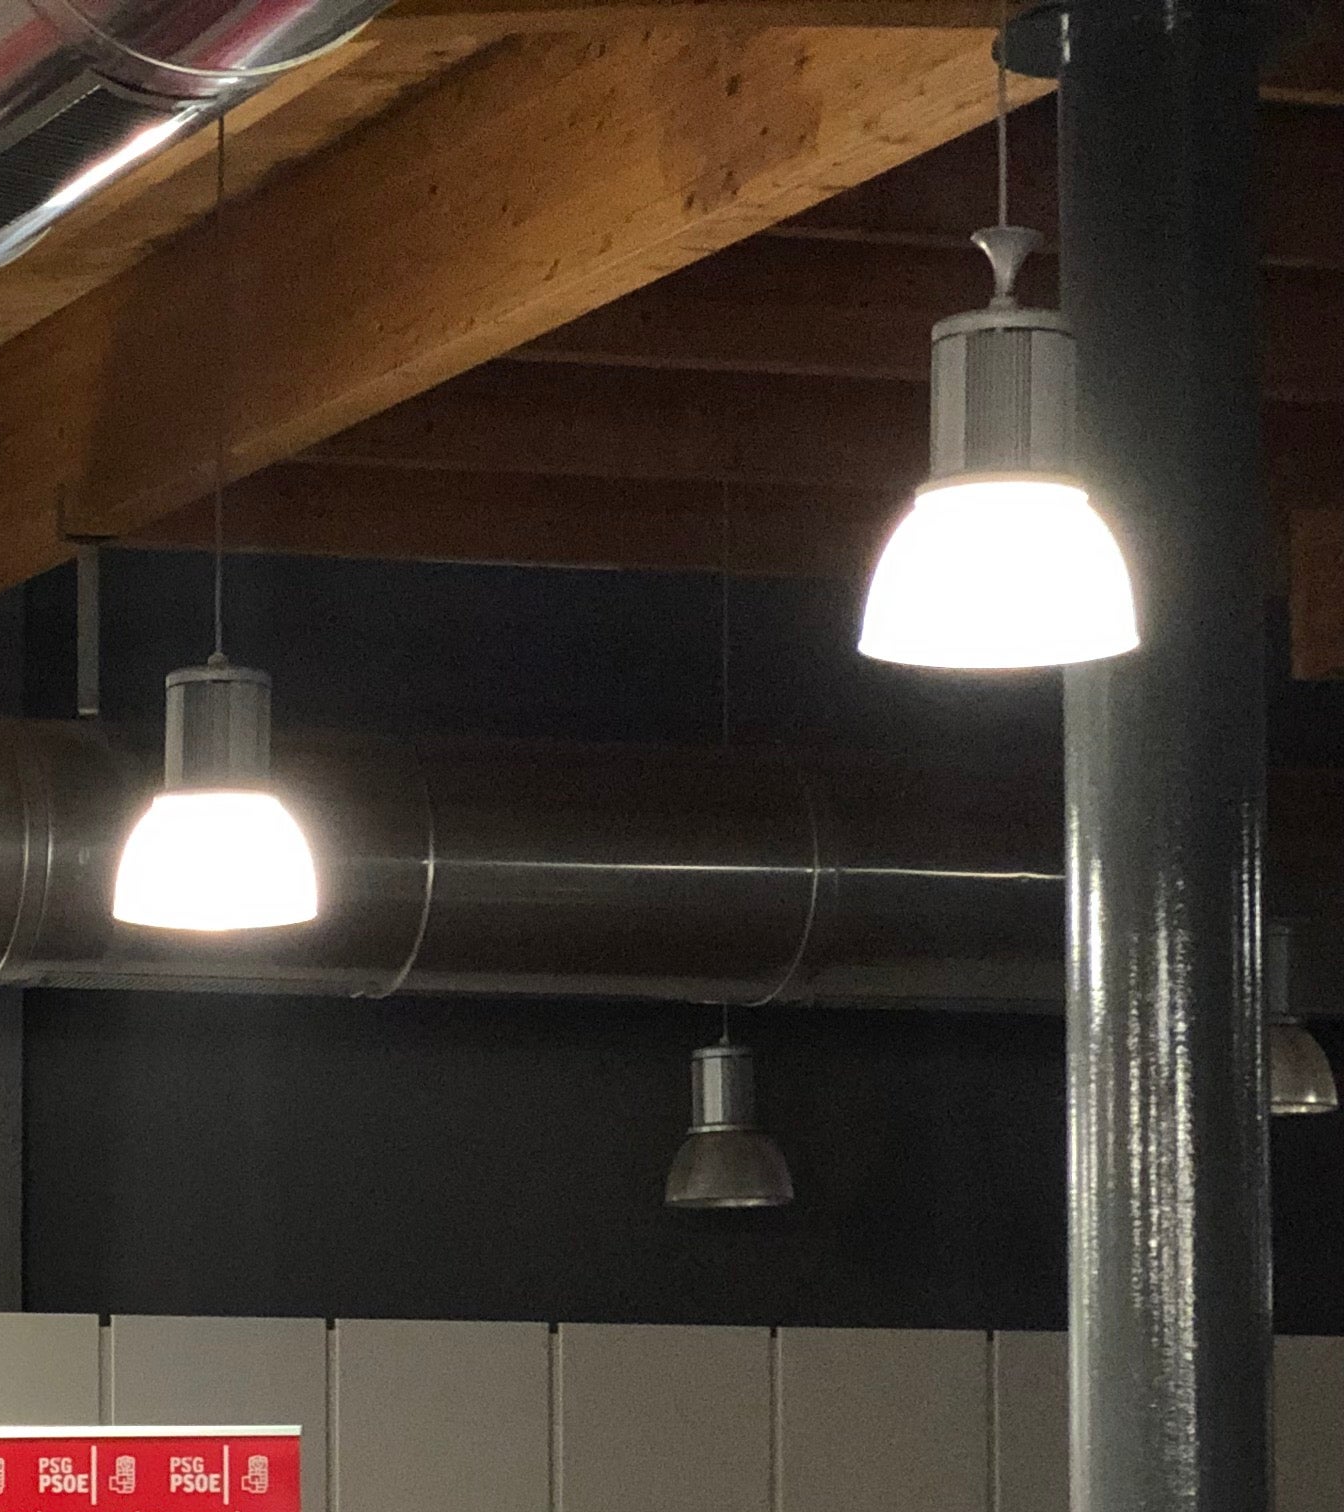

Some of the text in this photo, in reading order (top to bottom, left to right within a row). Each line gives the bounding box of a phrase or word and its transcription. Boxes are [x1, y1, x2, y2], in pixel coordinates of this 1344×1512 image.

[39, 1457, 72, 1474] PSG
[170, 1456, 204, 1474] PSG
[39, 1475, 88, 1494] PSOE
[170, 1474, 220, 1494] PSOE
